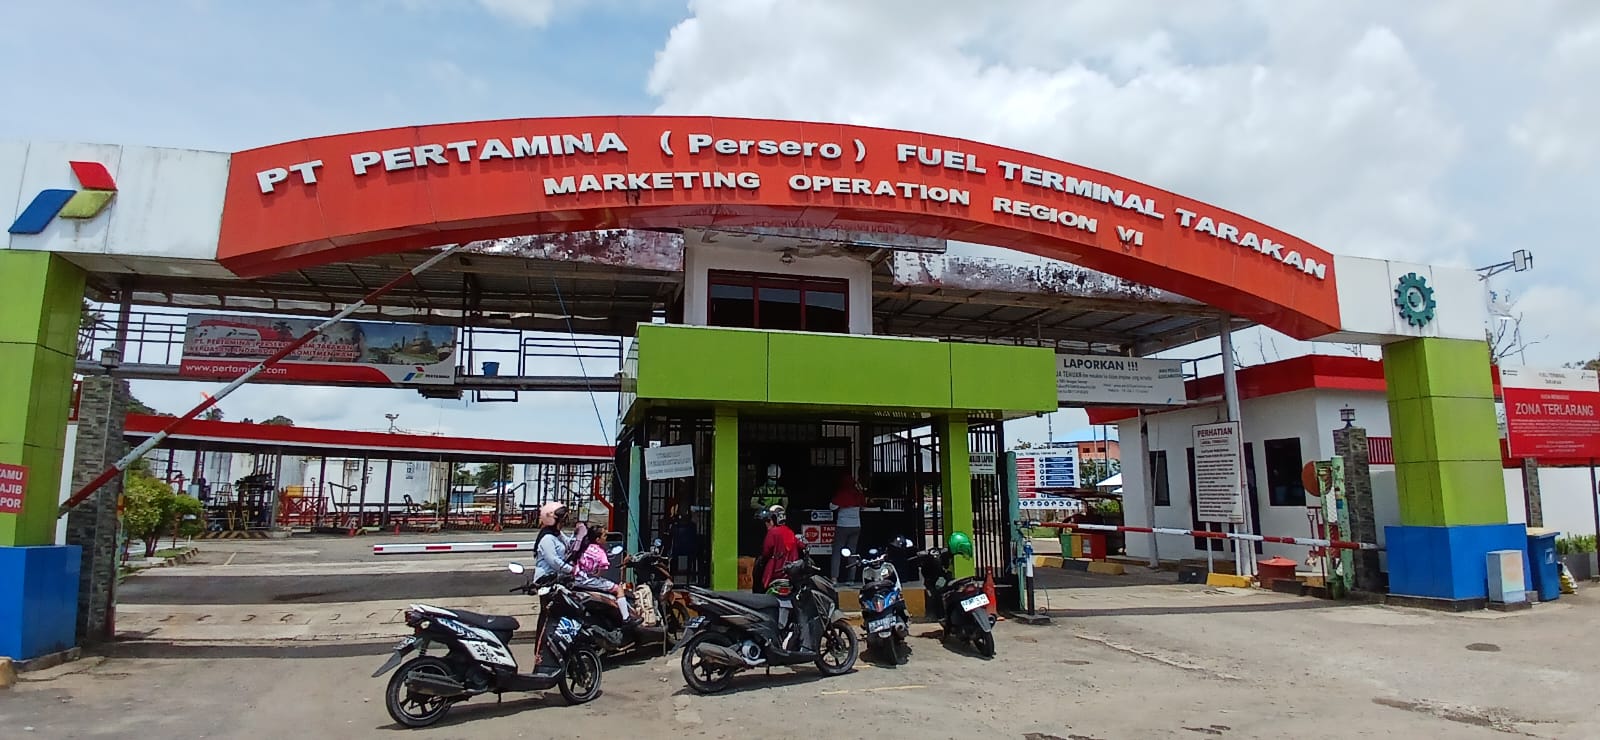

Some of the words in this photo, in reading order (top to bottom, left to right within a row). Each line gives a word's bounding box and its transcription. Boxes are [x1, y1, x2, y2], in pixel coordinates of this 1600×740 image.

[256, 159, 324, 194] PT
[350, 132, 628, 176] PERTAMINA
[897, 143, 987, 174] FUEL
[997, 160, 1165, 220] TERMINAL
[1174, 207, 1328, 281] TARAKAN
[543, 171, 761, 196] MARKETING
[788, 174, 970, 206] OPERATION
[992, 196, 1098, 233] REGION
[1115, 225, 1144, 247] VI
[185, 364, 287, 376] www.pertami.com
[1063, 358, 1124, 370] LAPORKAN
[1515, 403, 1541, 415] ZONA
[1542, 403, 1594, 416] TERLARANG
[1197, 427, 1233, 437] PERHATIAN
[0, 483, 22, 495] AJIB
[0, 497, 21, 508] POR
